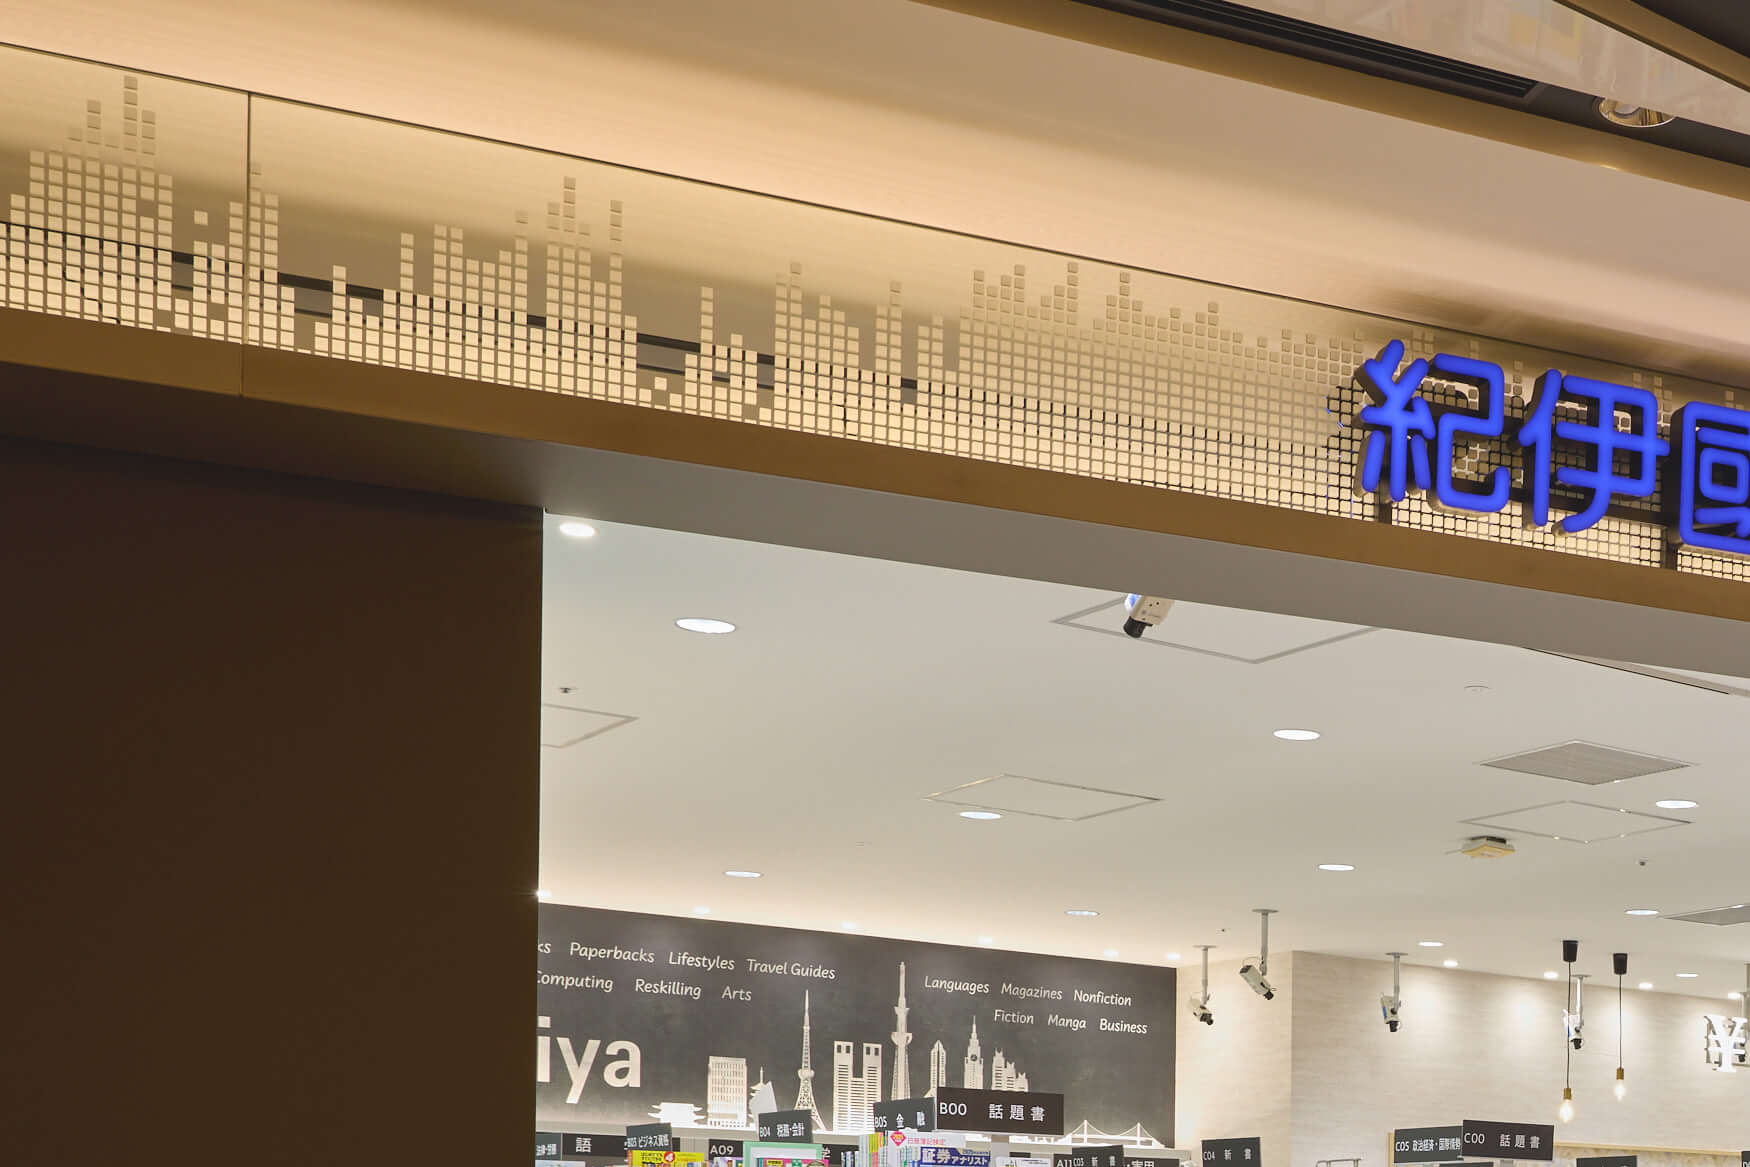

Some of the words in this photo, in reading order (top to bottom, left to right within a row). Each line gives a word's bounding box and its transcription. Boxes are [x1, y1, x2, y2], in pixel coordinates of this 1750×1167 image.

[570, 942, 655, 963] Paperbacks
[668, 951, 735, 971] Lifestyles
[747, 958, 787, 975] Travel
[791, 962, 835, 979] Guides
[635, 979, 701, 999] Reskilling
[722, 986, 752, 1001] Arts
[925, 976, 990, 994] Languages
[1001, 983, 1063, 1001] Magazines
[1074, 990, 1132, 1006] Nonfiction
[994, 1009, 1034, 1025] Fiction
[1047, 1014, 1086, 1031] Manga
[1099, 1018, 1148, 1035] Business
[537, 1016, 641, 1104] iya
[939, 1103, 967, 1116] B00
[988, 1104, 1045, 1122] 話題書
[710, 1145, 734, 1155] A09
[1500, 1134, 1541, 1149] 話題書
[920, 1146, 988, 1166] 証券アナリスト
